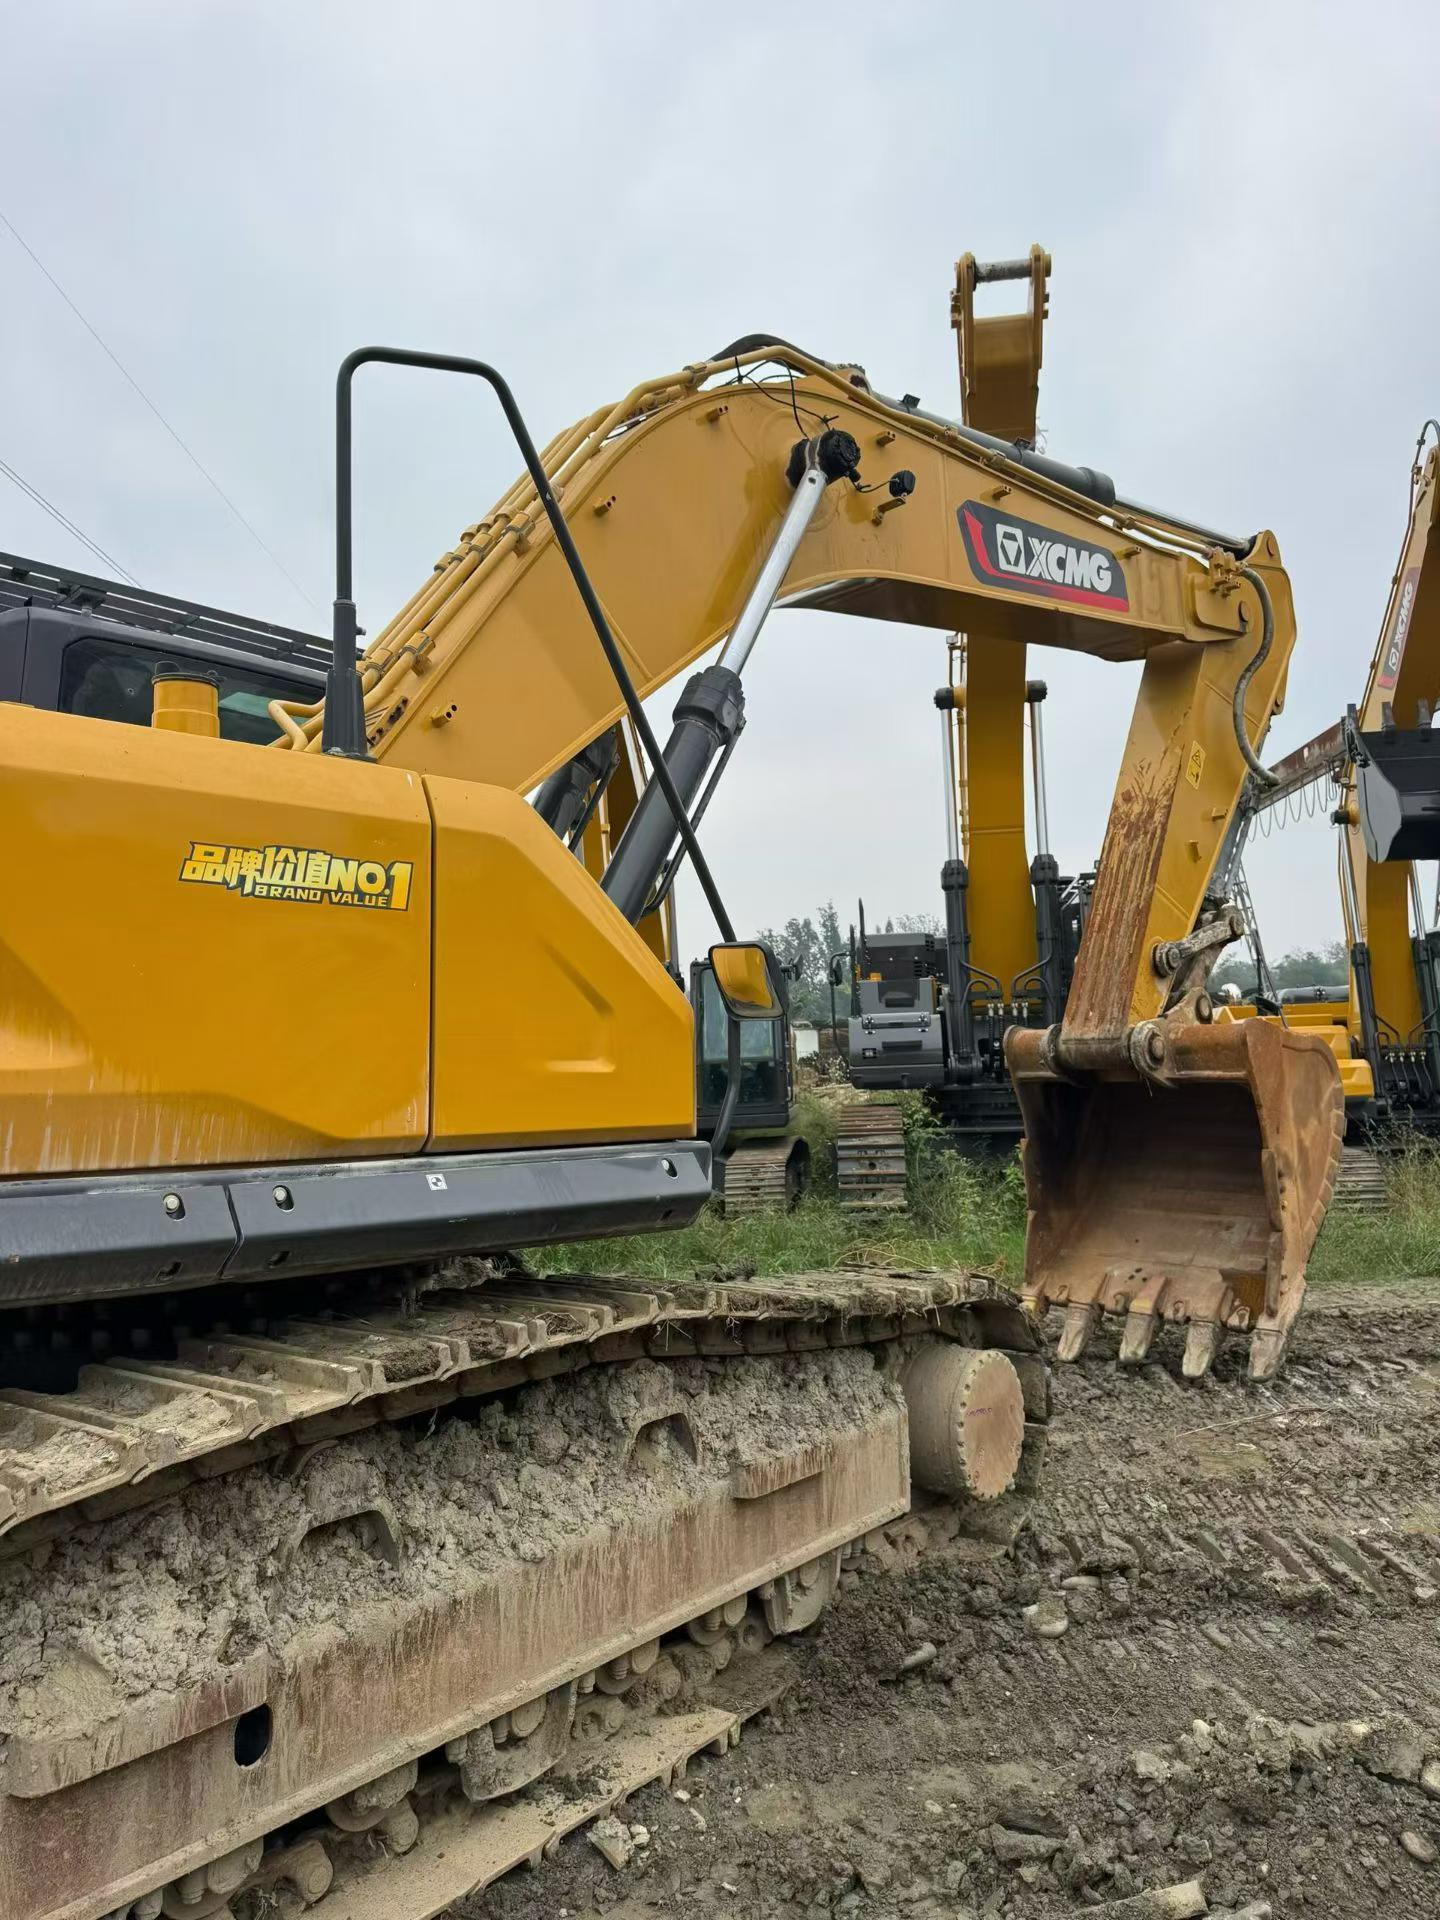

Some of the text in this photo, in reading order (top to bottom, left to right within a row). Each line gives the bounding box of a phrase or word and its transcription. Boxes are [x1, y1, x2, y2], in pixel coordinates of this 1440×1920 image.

[1026, 536, 1112, 592] XCMG
[1394, 581, 1413, 649] XCMG
[254, 884, 388, 907] BRAND VALUE
